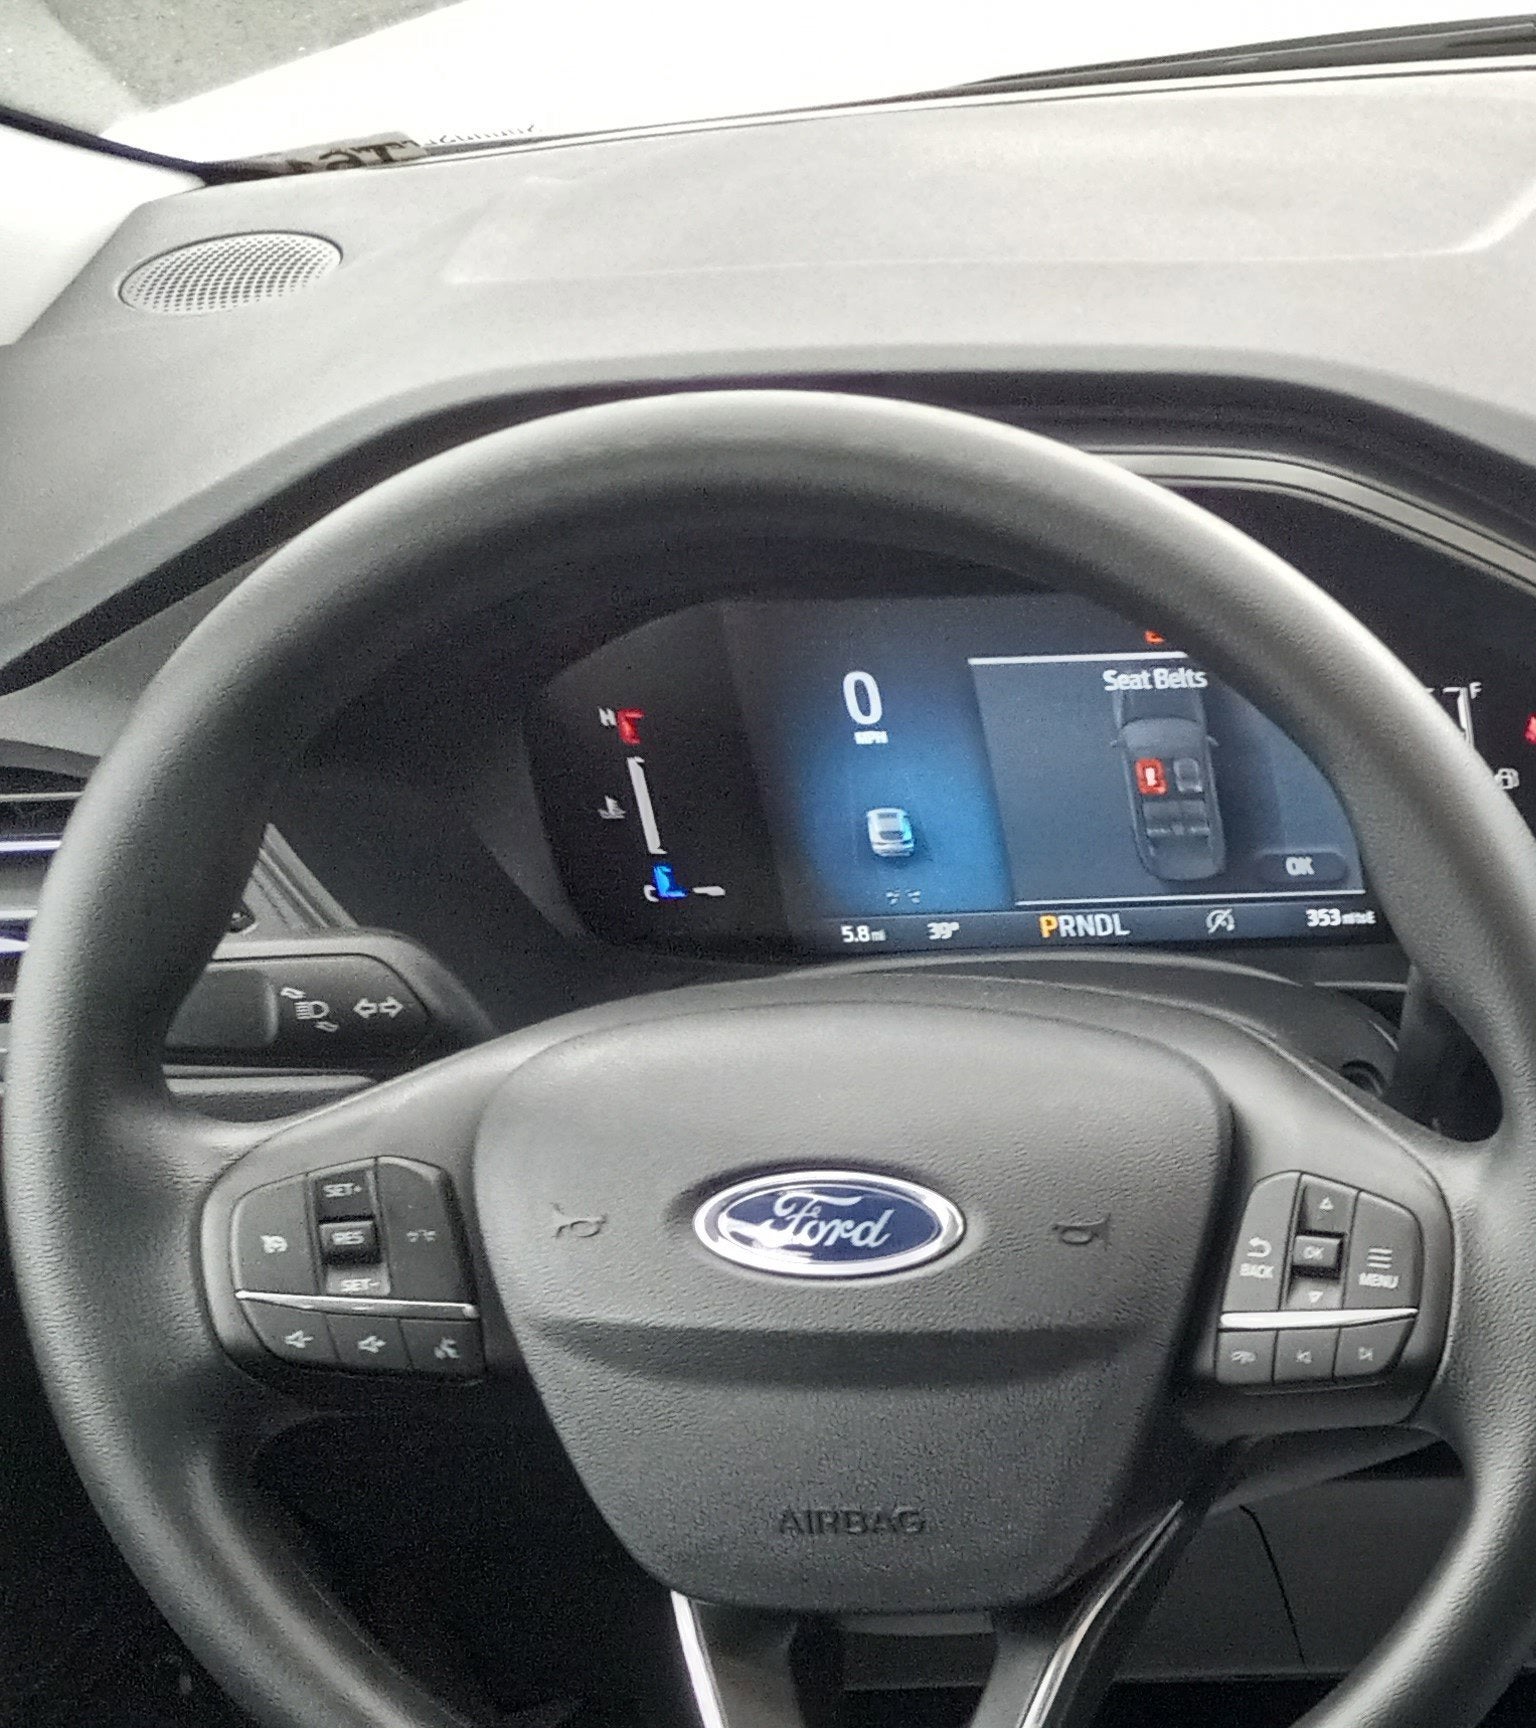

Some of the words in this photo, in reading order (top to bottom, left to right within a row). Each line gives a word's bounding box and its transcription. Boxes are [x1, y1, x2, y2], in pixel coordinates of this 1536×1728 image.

[1103, 669, 1153, 691] Seat
[1153, 667, 1208, 690] Belts
[843, 670, 883, 725] 0
[1469, 681, 1482, 699] F
[1285, 856, 1315, 876] OK
[772, 1191, 897, 1250] Ford
[1303, 1245, 1324, 1260] OK
[1239, 1262, 1275, 1280] BACK
[1358, 1272, 1400, 1290] MENU
[777, 1507, 928, 1536] AIRBAG
